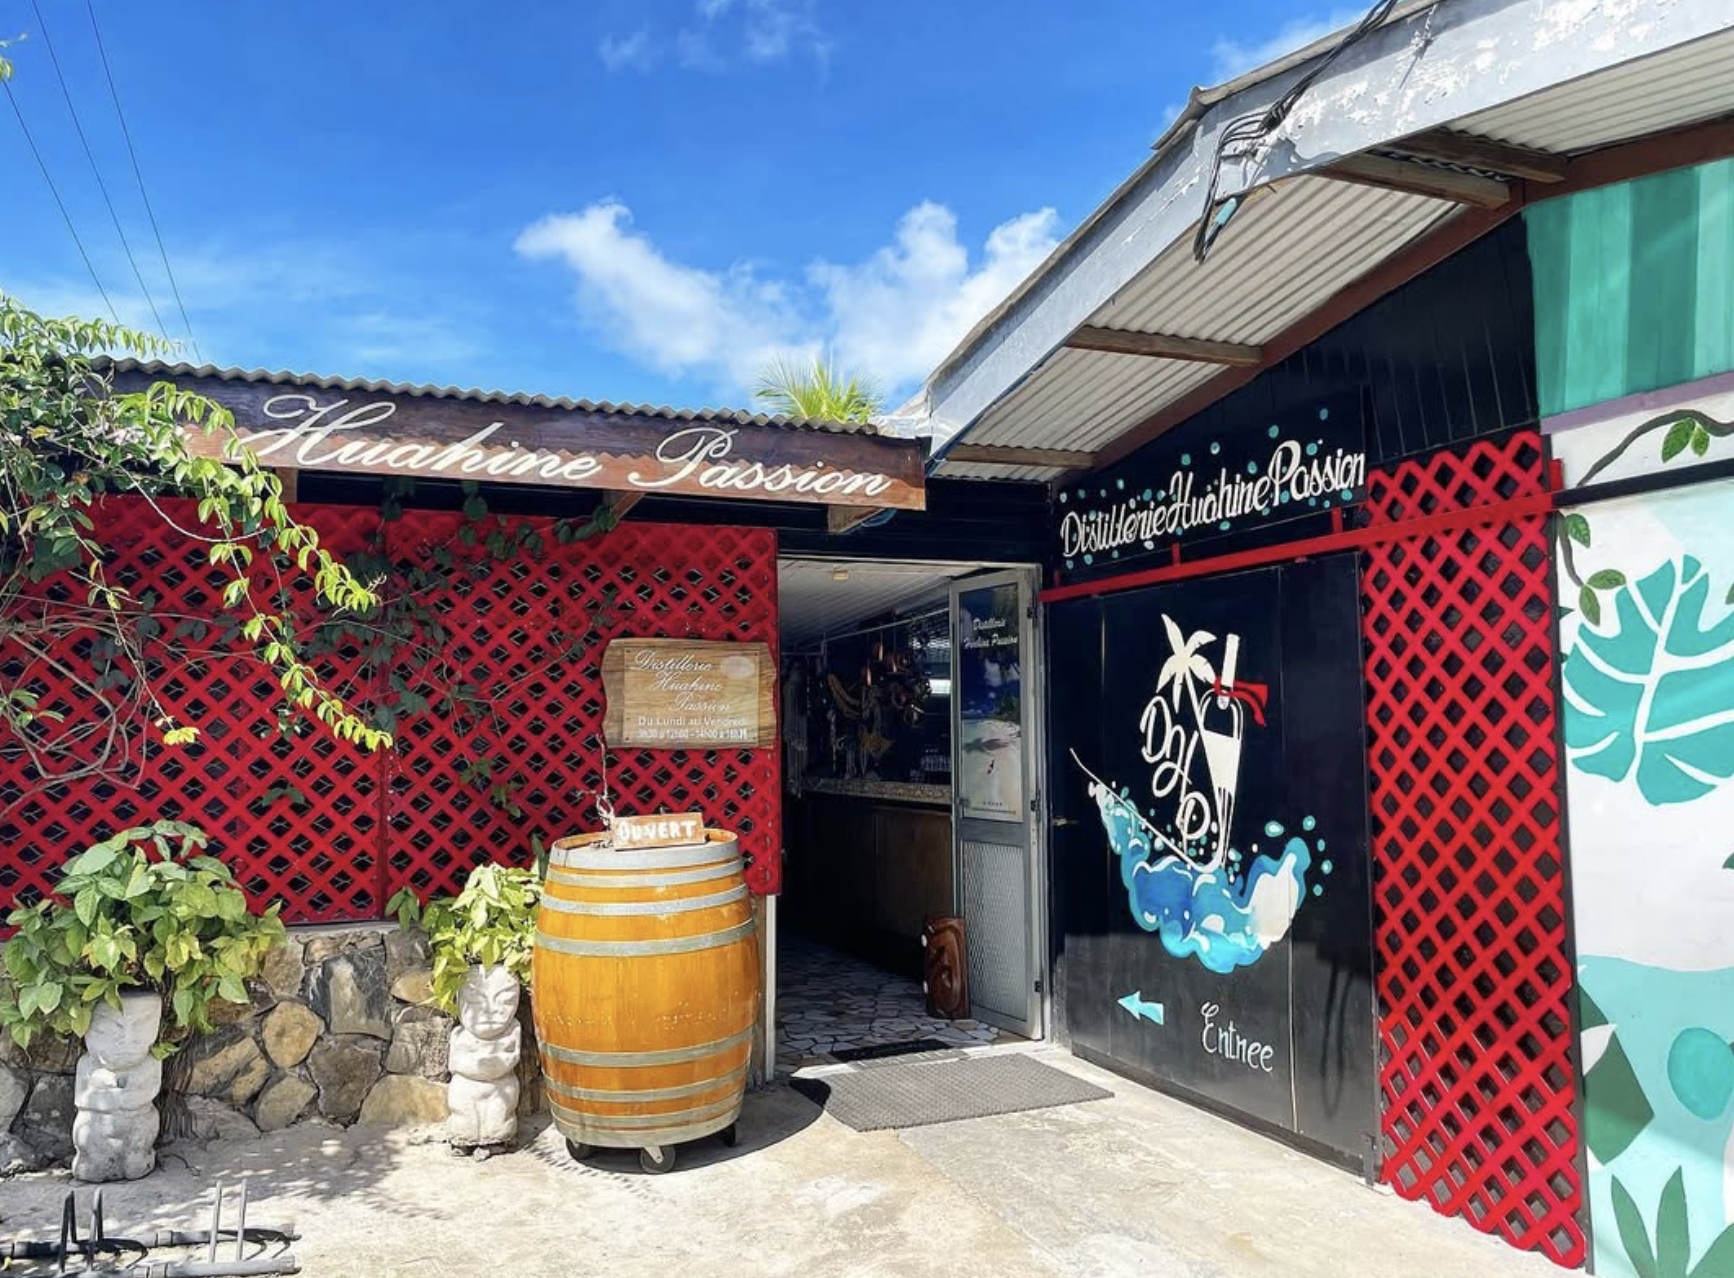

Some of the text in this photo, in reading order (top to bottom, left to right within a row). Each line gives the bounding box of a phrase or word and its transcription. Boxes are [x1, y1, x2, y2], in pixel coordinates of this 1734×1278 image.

[234, 394, 892, 497] Huahine Passion
[1060, 440, 1366, 558] Distillerie Huahine Passion
[634, 650, 713, 672] Distillerie
[649, 670, 723, 692] Huahine
[638, 716, 653, 726] Du
[656, 716, 686, 726] Lundi
[620, 819, 698, 841] OUVERT
[1201, 1001, 1274, 1073] Entree
